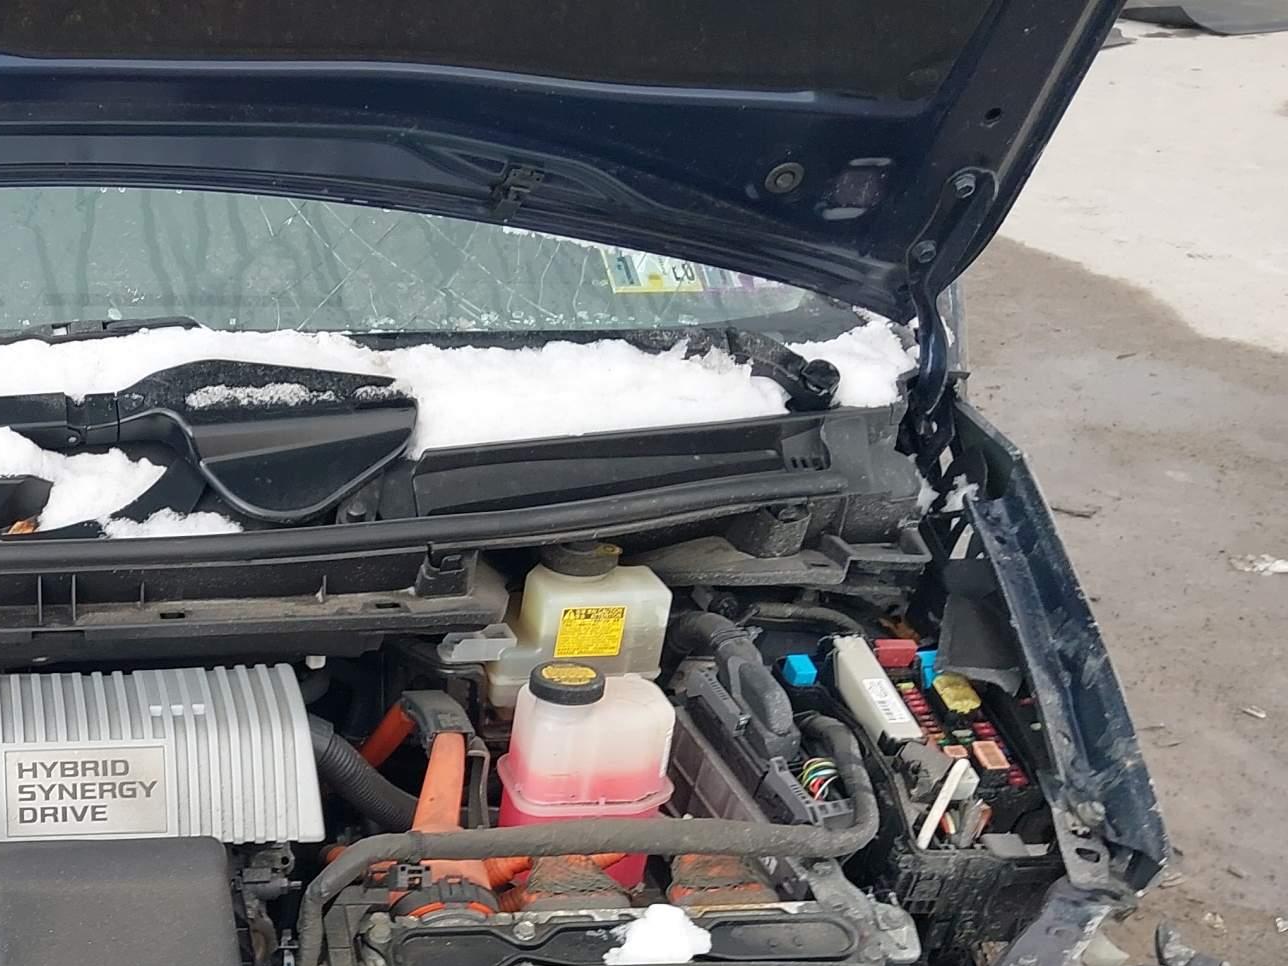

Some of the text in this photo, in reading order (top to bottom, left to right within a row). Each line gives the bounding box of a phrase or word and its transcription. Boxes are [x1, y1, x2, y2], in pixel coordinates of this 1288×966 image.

[17, 759, 130, 779] HYBRID
[18, 780, 158, 802] SYNERGY
[19, 805, 108, 824] DRIVE
